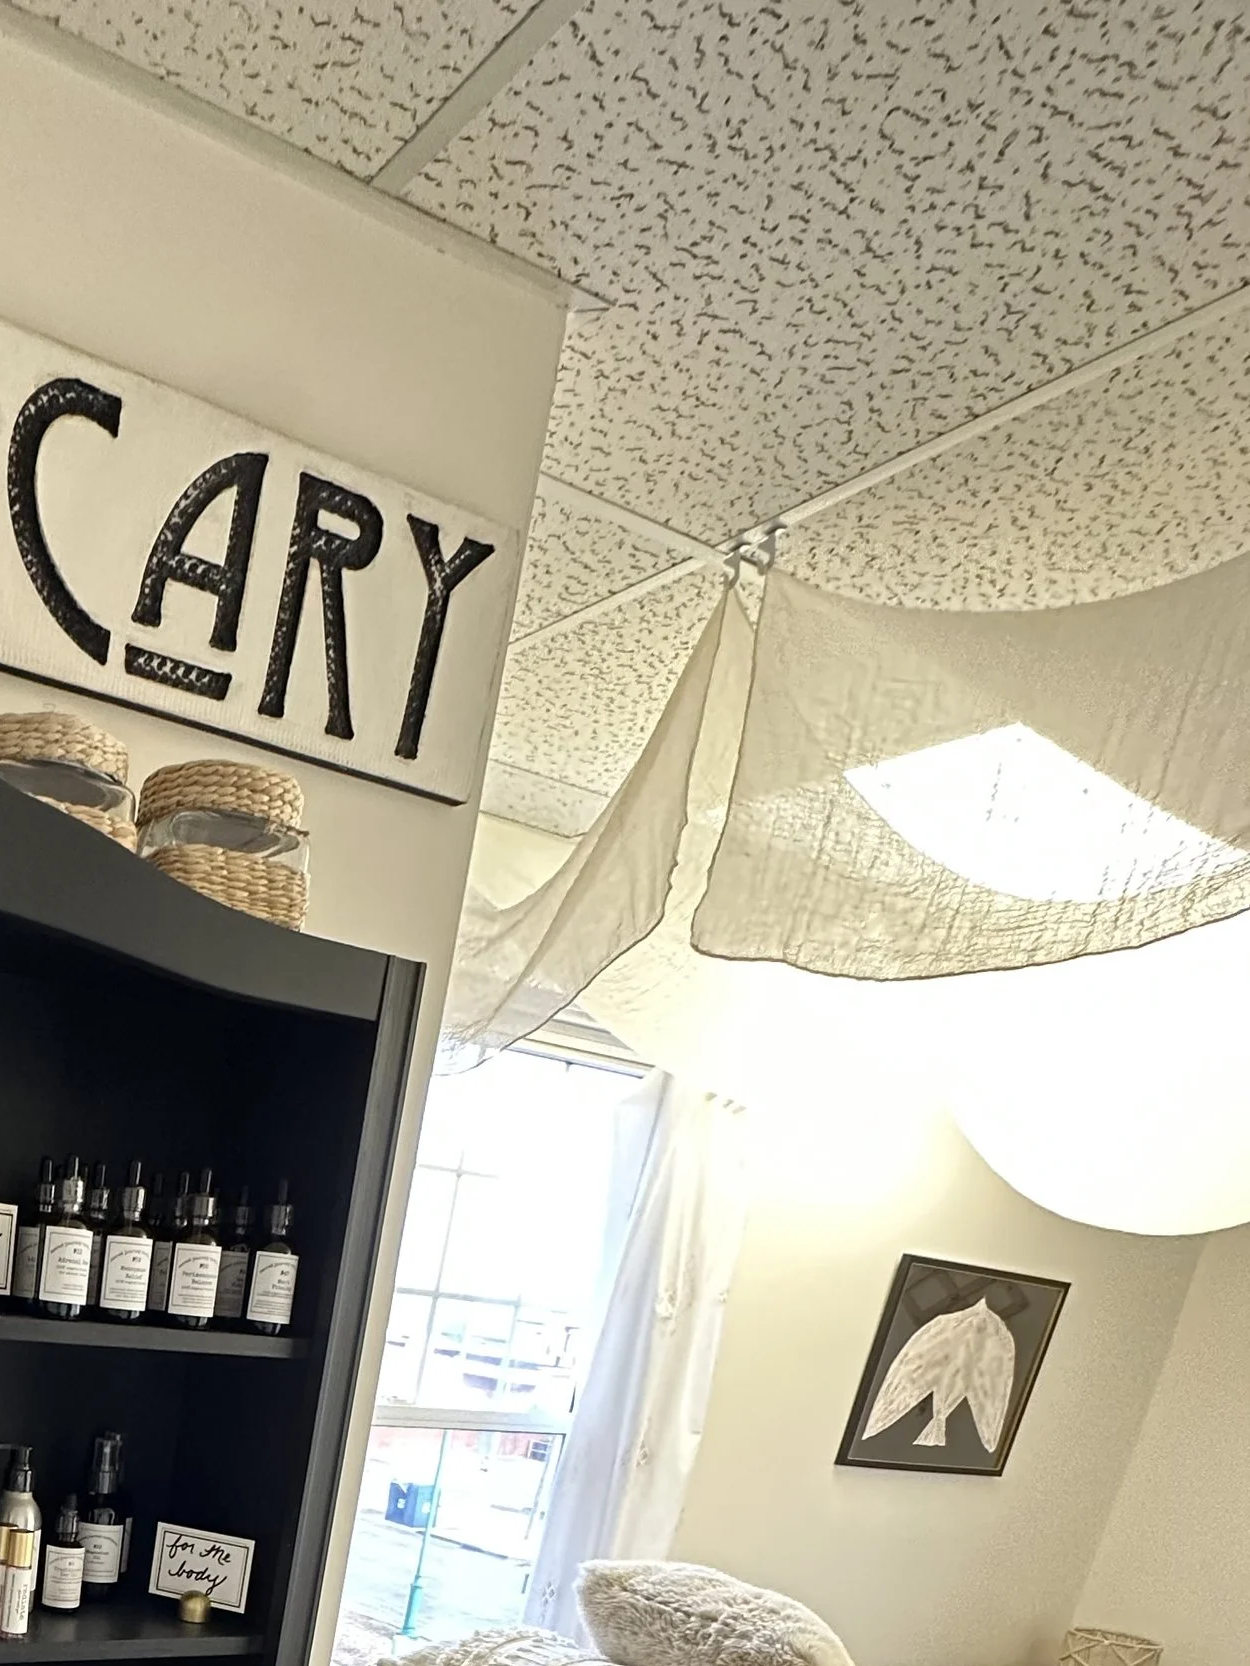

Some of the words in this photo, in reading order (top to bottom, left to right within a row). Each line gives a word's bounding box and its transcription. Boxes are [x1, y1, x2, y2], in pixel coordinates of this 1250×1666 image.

[166, 1535, 196, 1559] for
[199, 1544, 232, 1566] the
[168, 1561, 228, 1597] body
